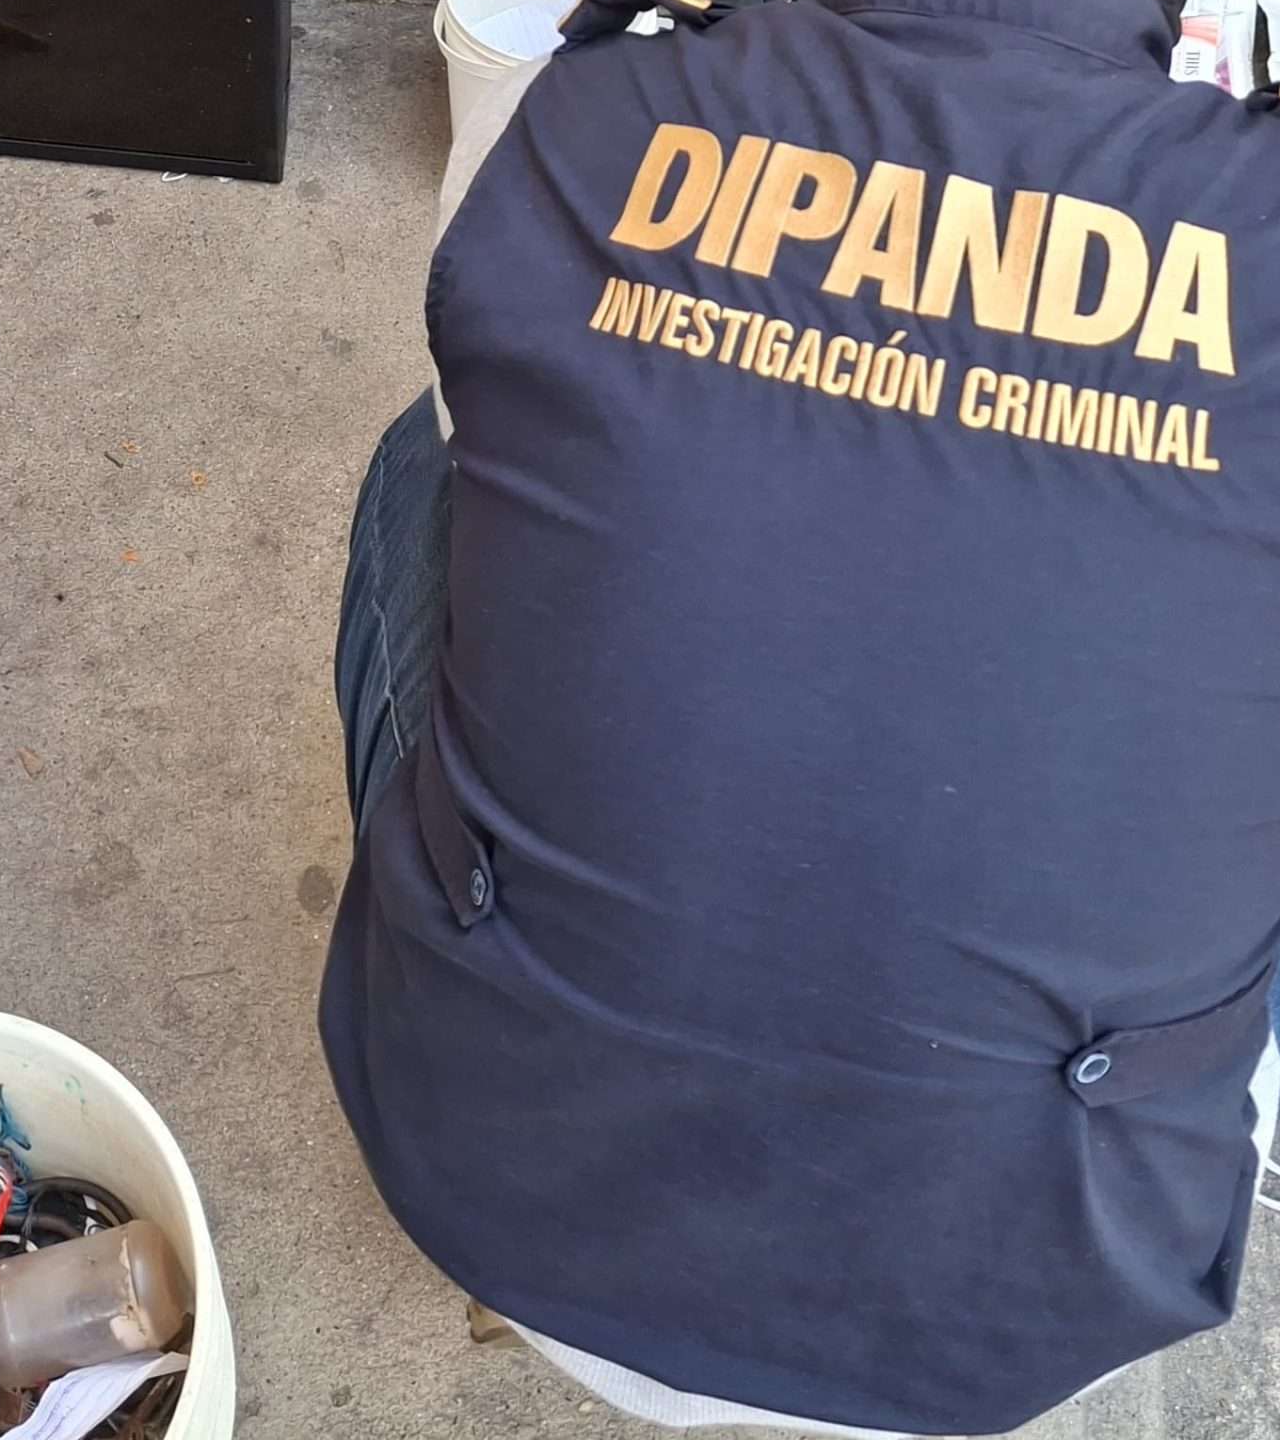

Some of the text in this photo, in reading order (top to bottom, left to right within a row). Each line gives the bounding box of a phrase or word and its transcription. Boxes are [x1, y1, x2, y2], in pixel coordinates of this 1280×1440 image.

[608, 122, 1238, 377] DIPANDA
[588, 276, 1220, 474] INVESTIGACIÓN CRIMINAL
